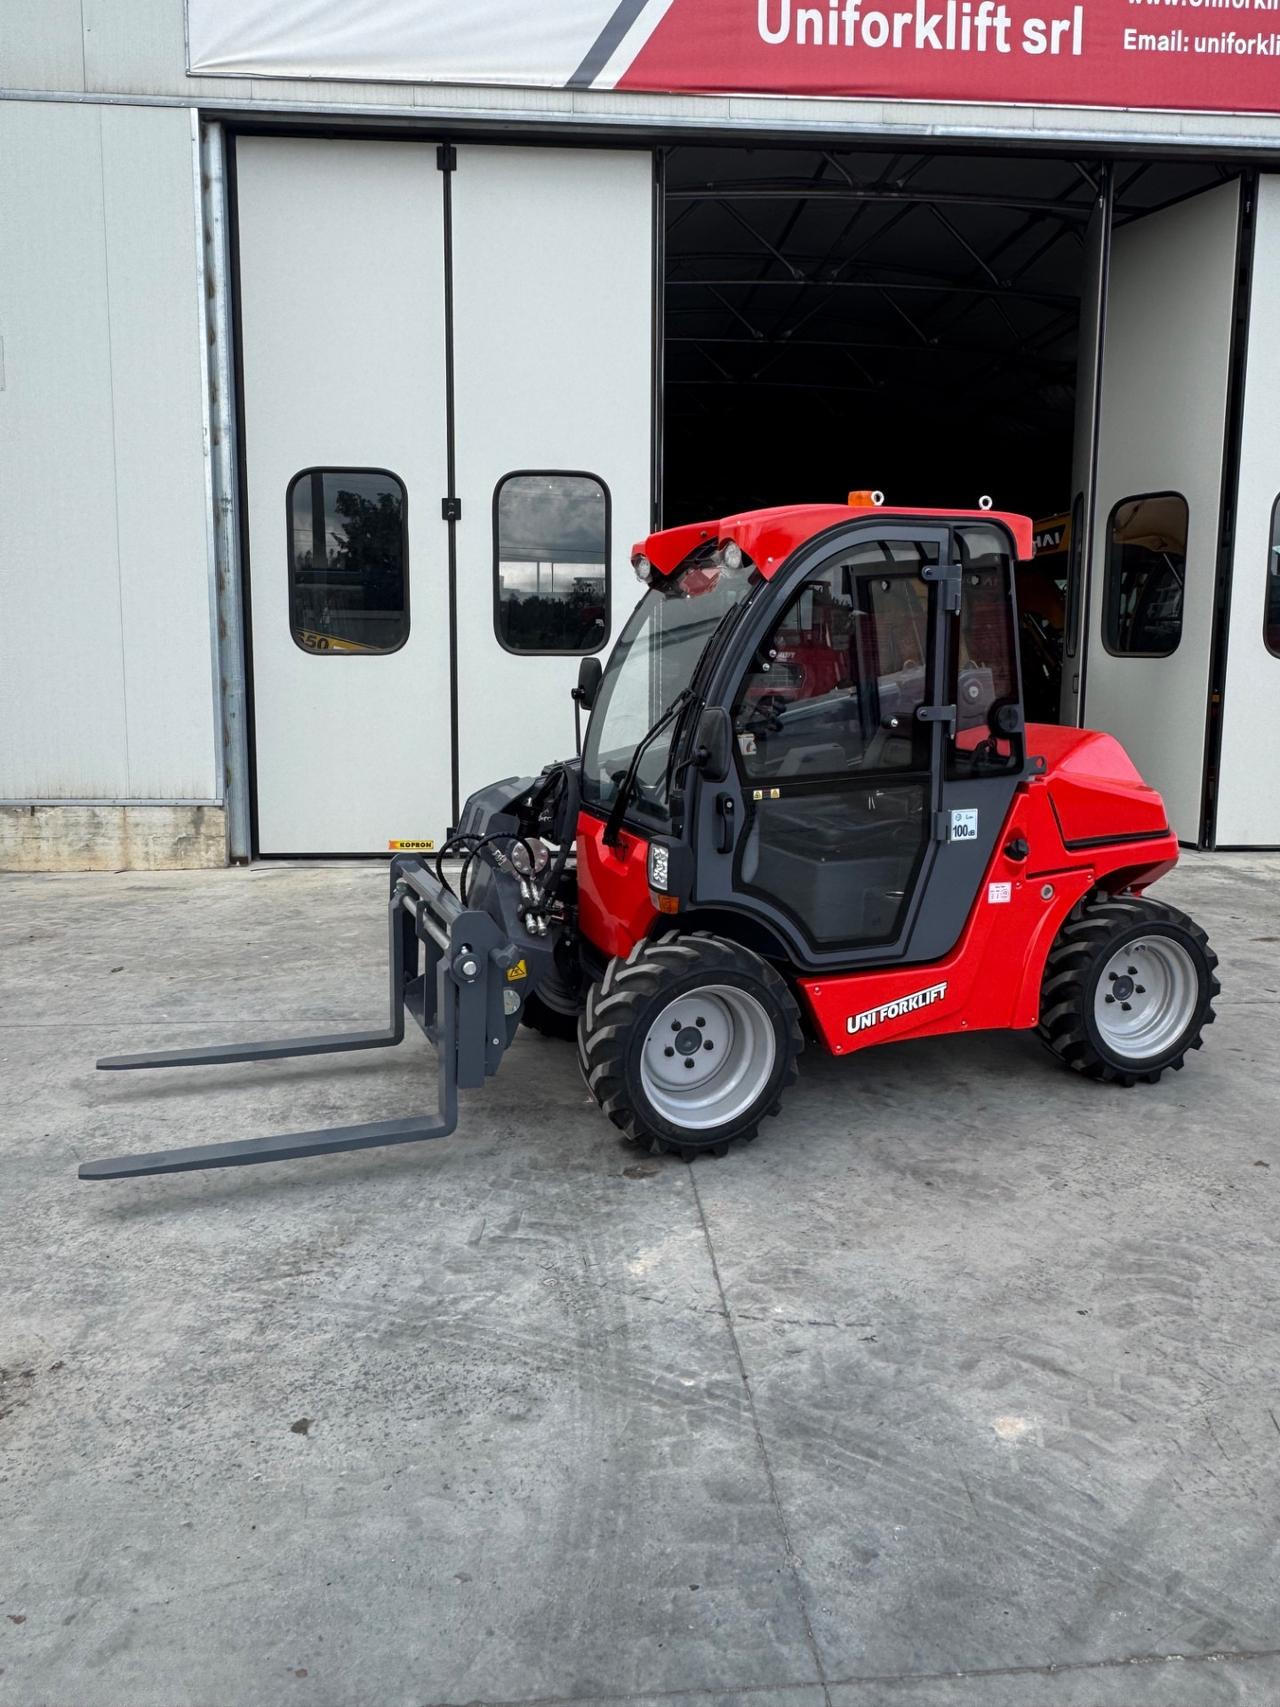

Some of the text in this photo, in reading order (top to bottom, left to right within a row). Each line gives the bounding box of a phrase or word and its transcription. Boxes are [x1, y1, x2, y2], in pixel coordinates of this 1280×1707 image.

[758, 0, 1083, 55] Uniforklift srl
[1123, 28, 1189, 52] Email:
